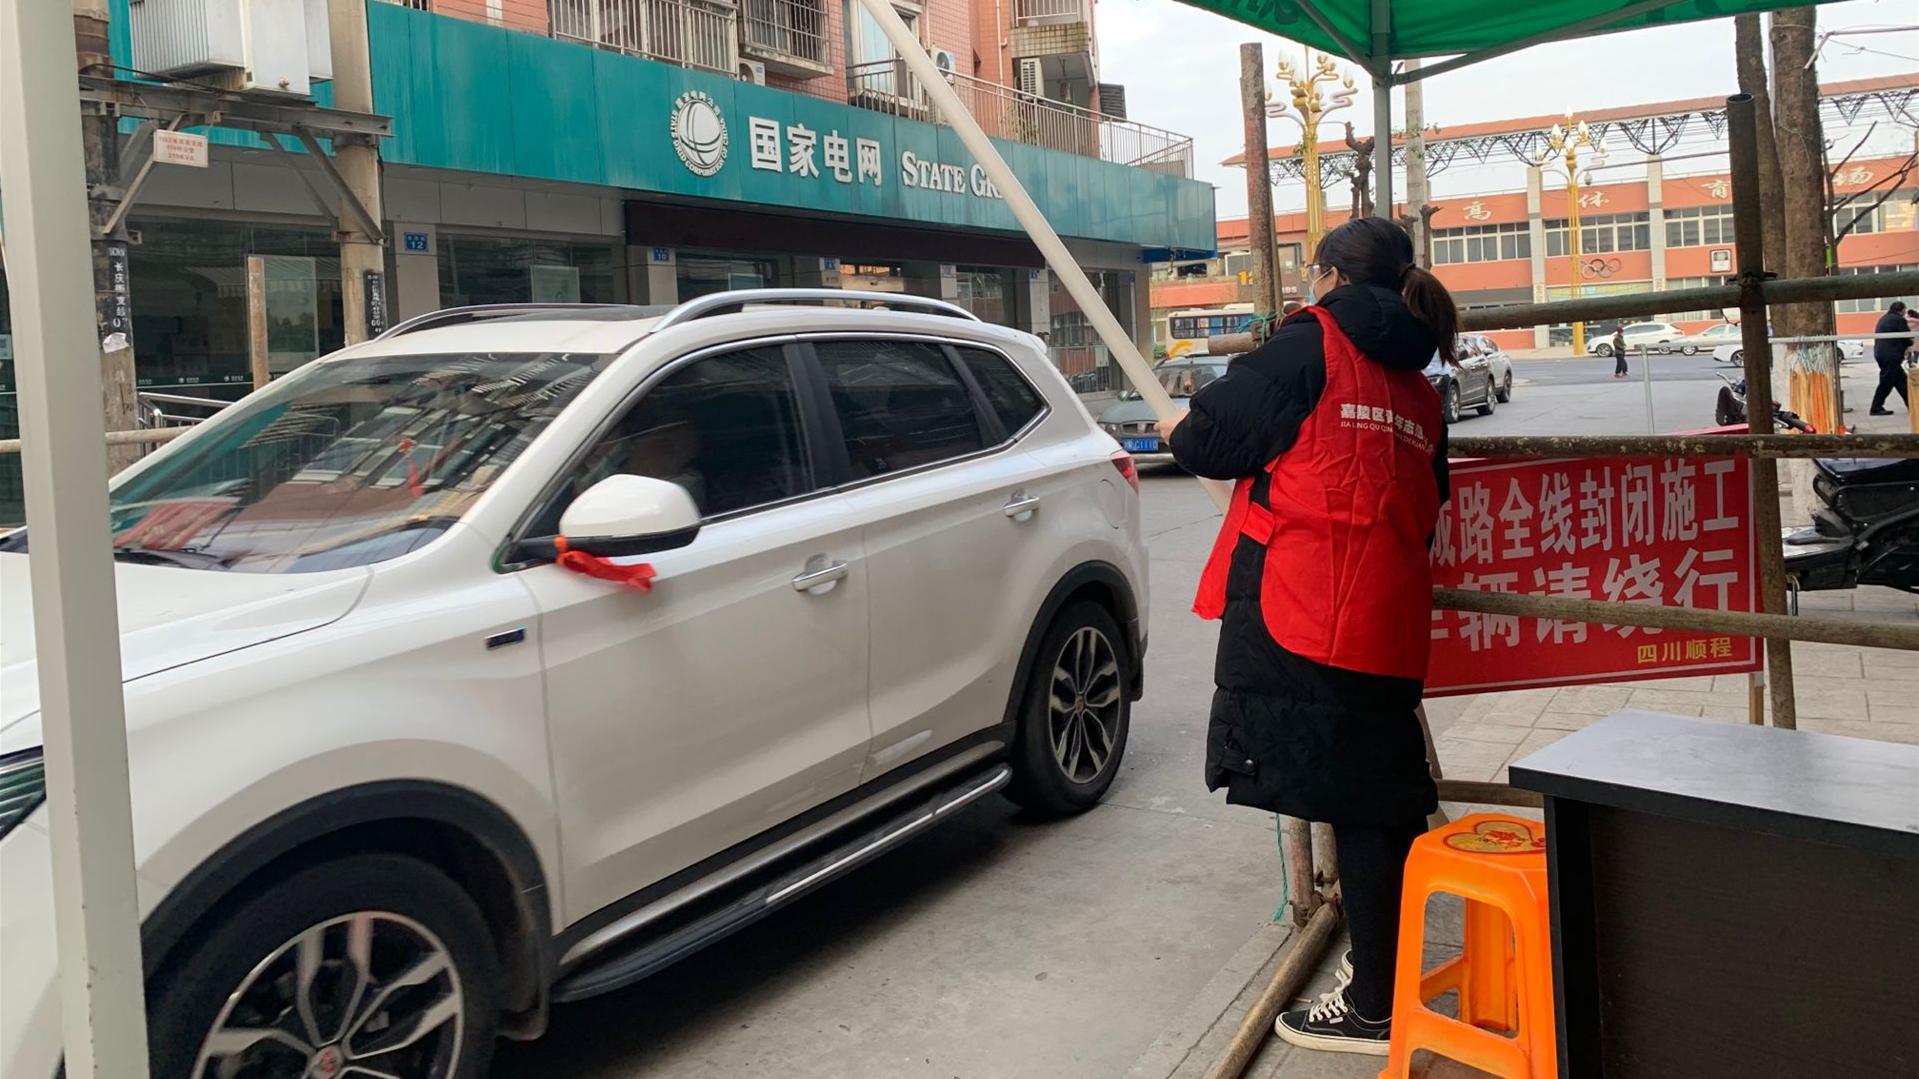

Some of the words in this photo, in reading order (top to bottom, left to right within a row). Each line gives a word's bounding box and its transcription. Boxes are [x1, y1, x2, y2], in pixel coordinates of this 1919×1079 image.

[749, 116, 882, 187] 国家电网
[902, 151, 966, 194] STATE
[970, 163, 1004, 199] GR
[1430, 548, 1739, 652] 辆请绕行
[1637, 637, 1733, 664] 四川顺程
